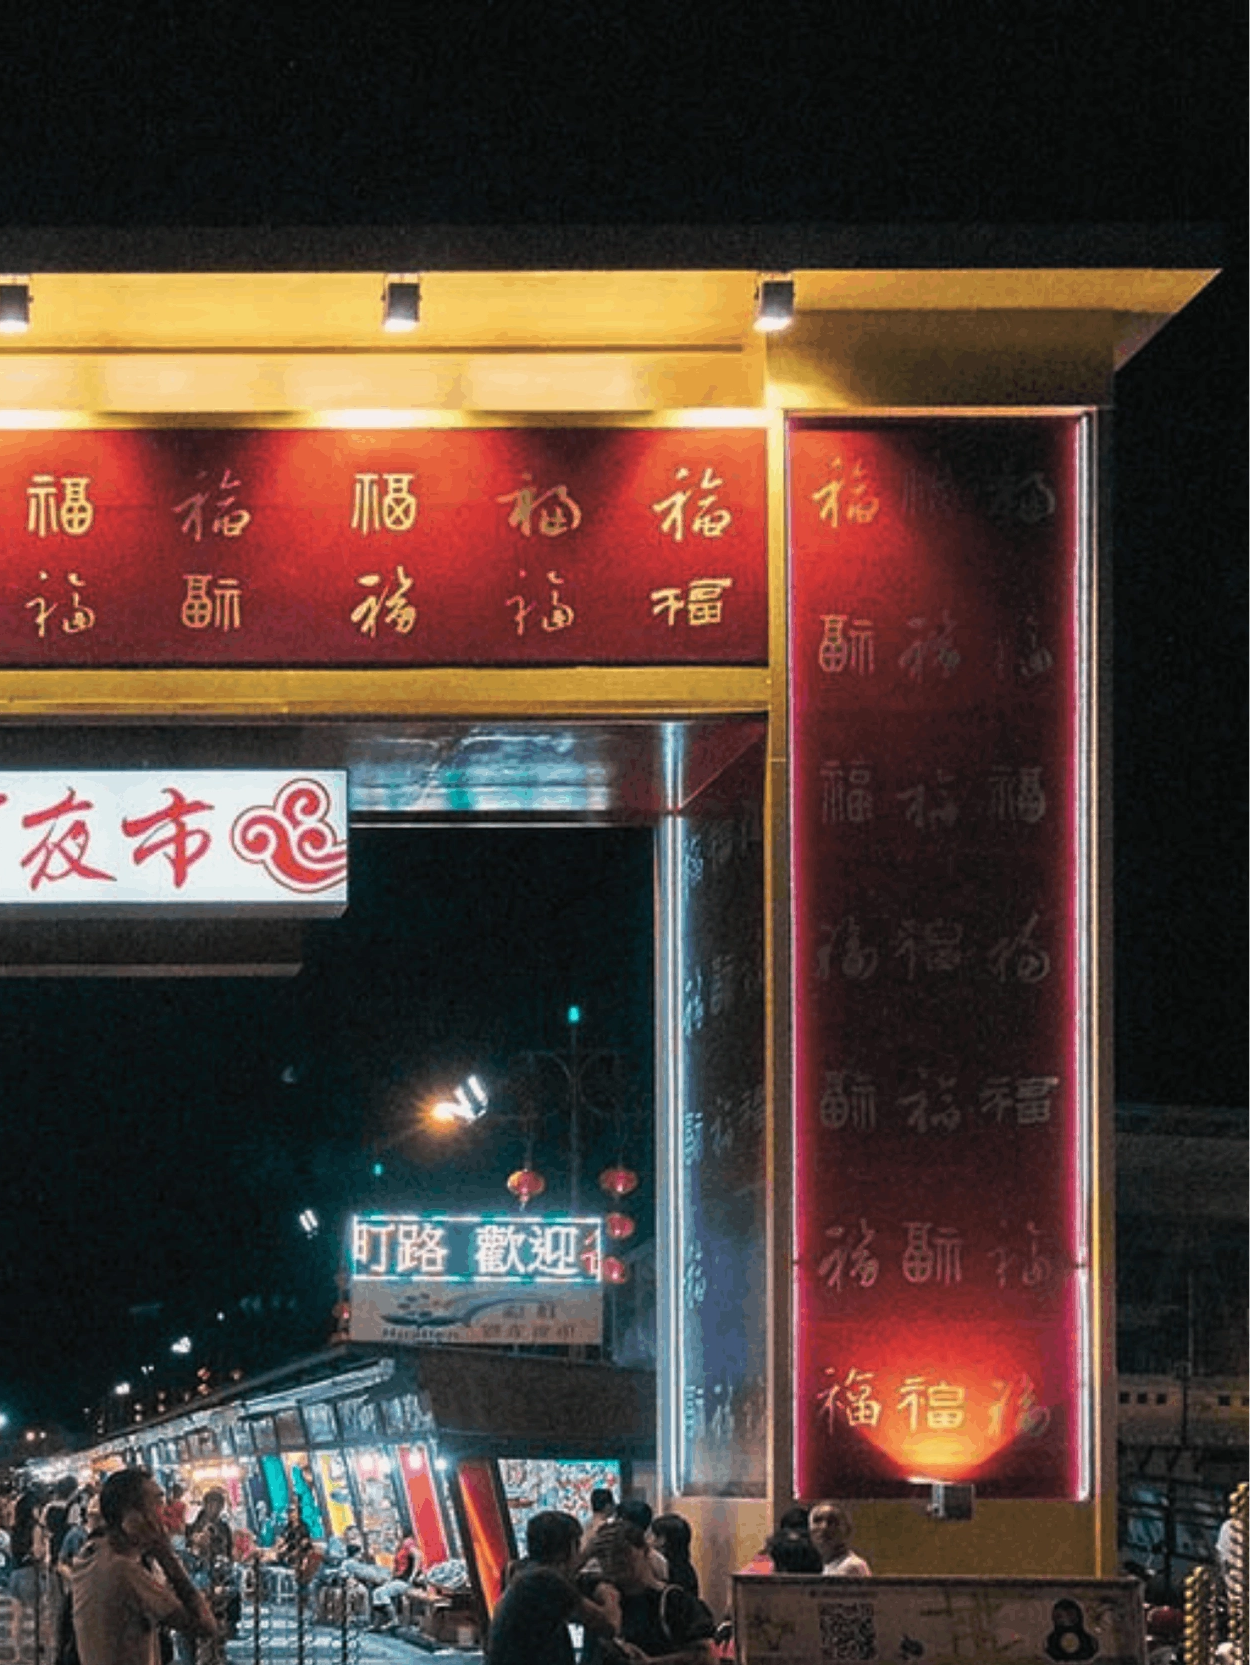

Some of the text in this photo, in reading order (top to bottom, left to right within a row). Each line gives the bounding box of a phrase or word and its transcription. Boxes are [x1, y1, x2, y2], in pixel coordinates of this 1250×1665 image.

[27, 475, 94, 536] 福
[173, 469, 252, 542] 福
[353, 473, 416, 534] 福
[498, 475, 582, 536] 福
[652, 467, 732, 542] 福
[811, 459, 879, 528] 福
[27, 573, 95, 637] 福
[352, 567, 417, 637] 福
[508, 570, 575, 634] 福
[651, 577, 732, 626] 福
[819, 614, 875, 675] 福
[979, 1076, 1059, 1125] 福
[817, 1365, 881, 1432] 福
[897, 1373, 966, 1430] 福
